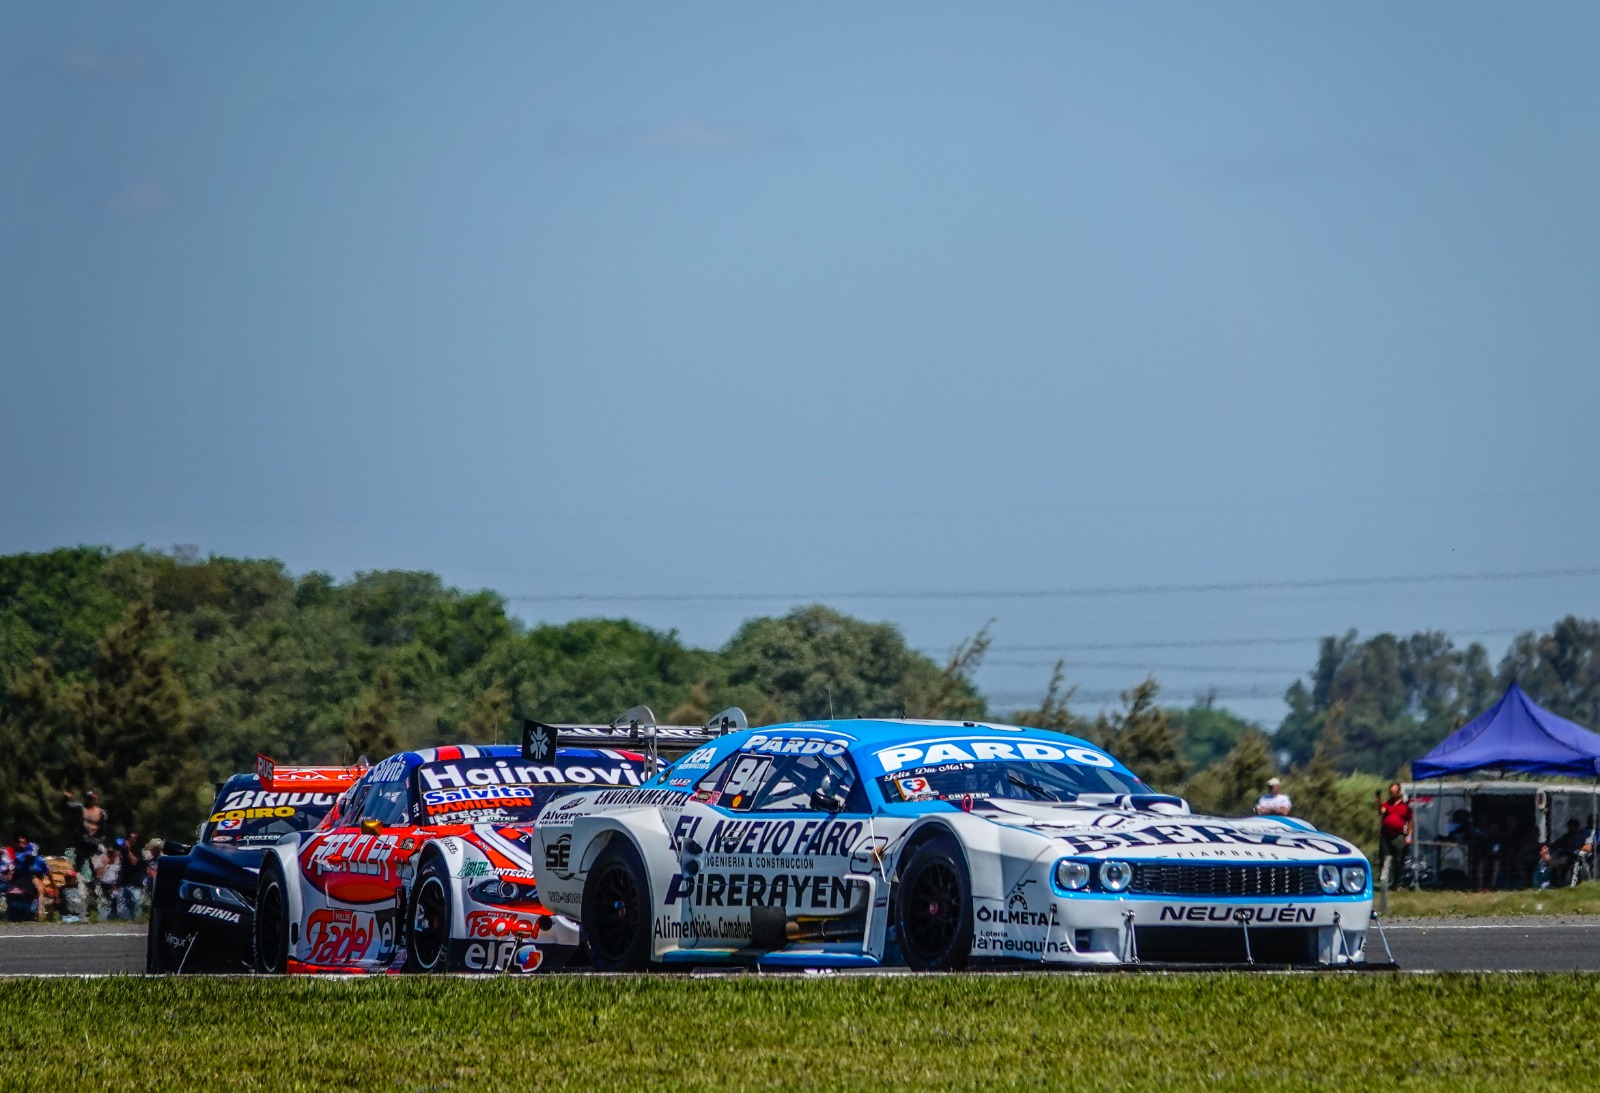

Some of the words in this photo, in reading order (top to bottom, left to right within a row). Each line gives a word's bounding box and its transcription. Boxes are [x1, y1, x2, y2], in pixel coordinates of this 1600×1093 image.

[684, 747, 717, 764] RA
[742, 735, 848, 756] PARDO
[367, 753, 406, 783] Salvita
[878, 742, 1114, 773] PARDO
[257, 757, 273, 781] RUS
[725, 758, 768, 797] 94
[425, 786, 532, 805] Salvita
[593, 788, 694, 808] ENVIRONMENTAL
[210, 807, 296, 823] COIRO
[426, 798, 533, 816] HAMILTON
[428, 809, 509, 824] INTEGRA
[541, 811, 591, 821] Alvar
[670, 815, 703, 850] EL
[706, 820, 795, 855] NUEVO
[794, 821, 863, 857] FARO
[546, 844, 571, 868] SE
[705, 856, 746, 868] NGENIERIA
[748, 857, 754, 868] &
[756, 857, 814, 869] CONSTRUCCIÓN
[1176, 850, 1279, 860] FIAMBRES
[664, 874, 852, 909] PIRERAYEN
[188, 904, 241, 924] INFINIA
[336, 913, 351, 921] POLLOS
[977, 906, 1060, 926] OILMETAL
[1160, 903, 1315, 924] NEUQUÉN
[466, 910, 541, 939] Fadel
[654, 914, 713, 939] Alimenticia
[719, 916, 752, 938] Comahue
[306, 909, 374, 964] Fadel
[465, 942, 516, 971] elf
